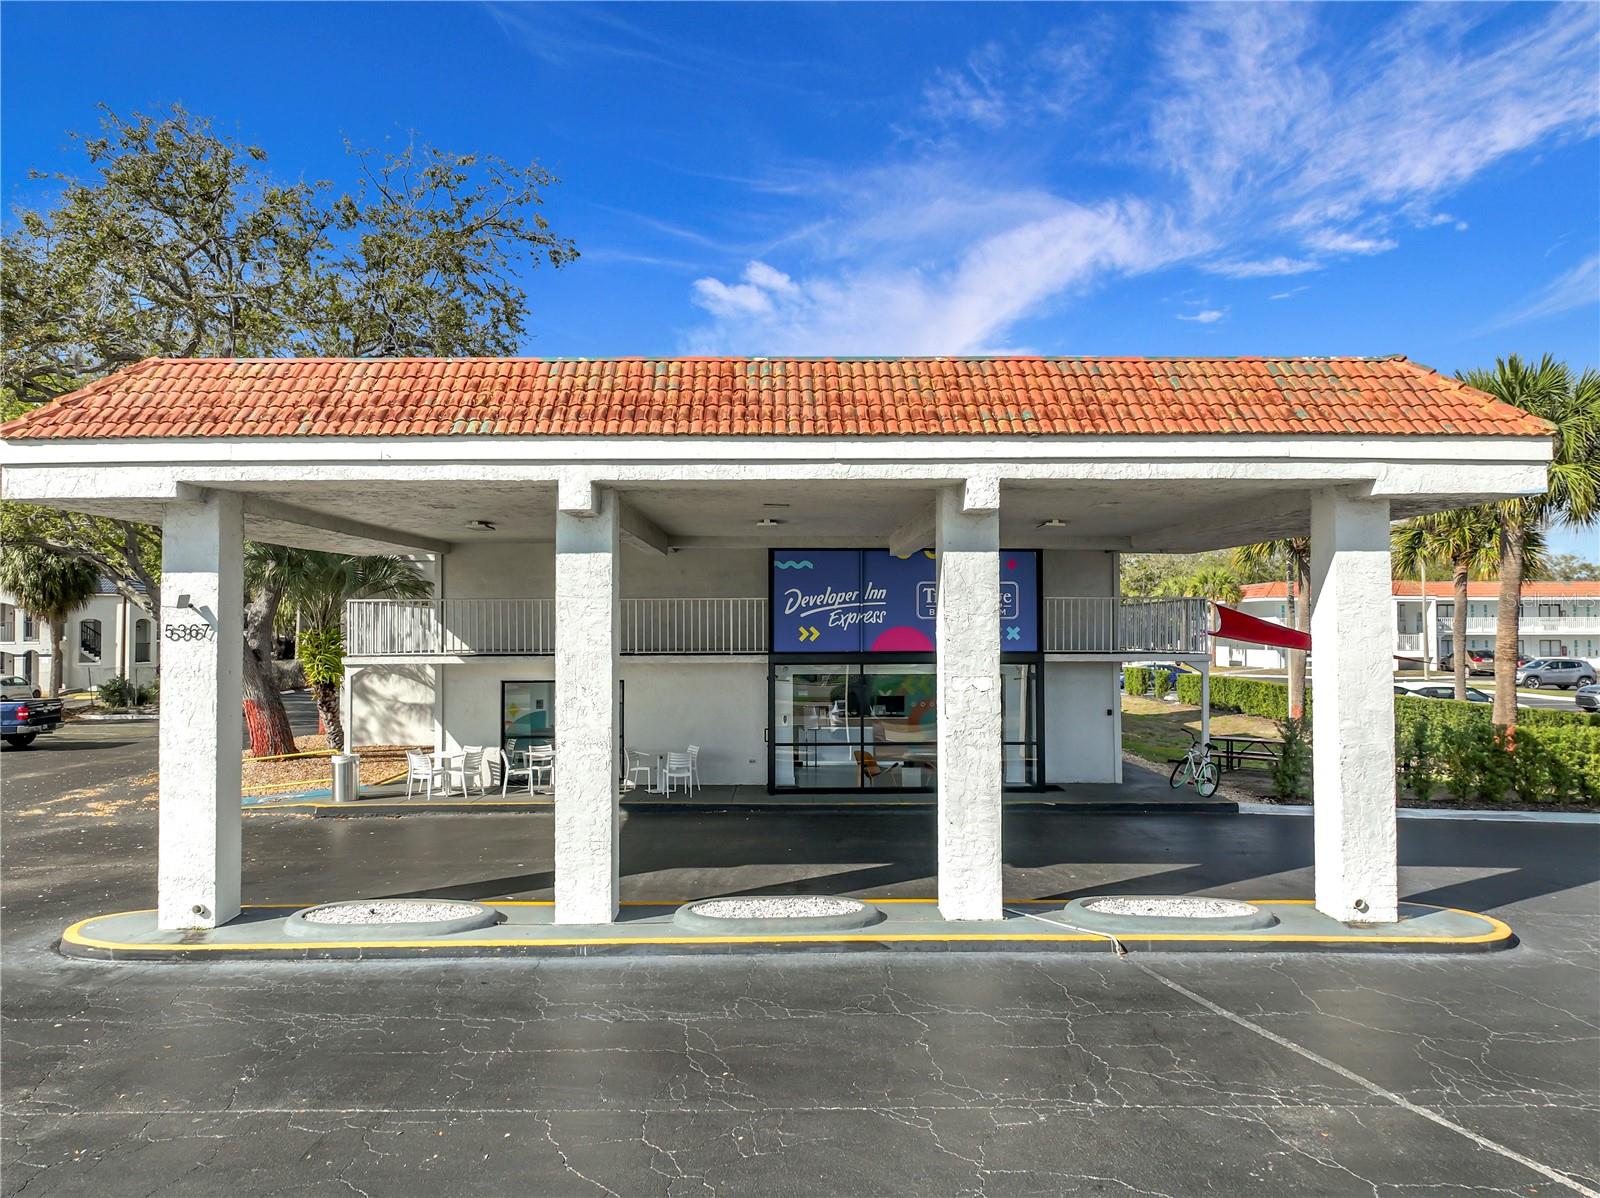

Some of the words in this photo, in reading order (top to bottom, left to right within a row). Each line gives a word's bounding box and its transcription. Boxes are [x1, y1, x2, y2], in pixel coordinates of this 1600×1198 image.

[784, 586, 860, 614] Developer
[864, 582, 887, 600] Inn
[828, 609, 887, 631] Express
[165, 624, 210, 639] 5367
